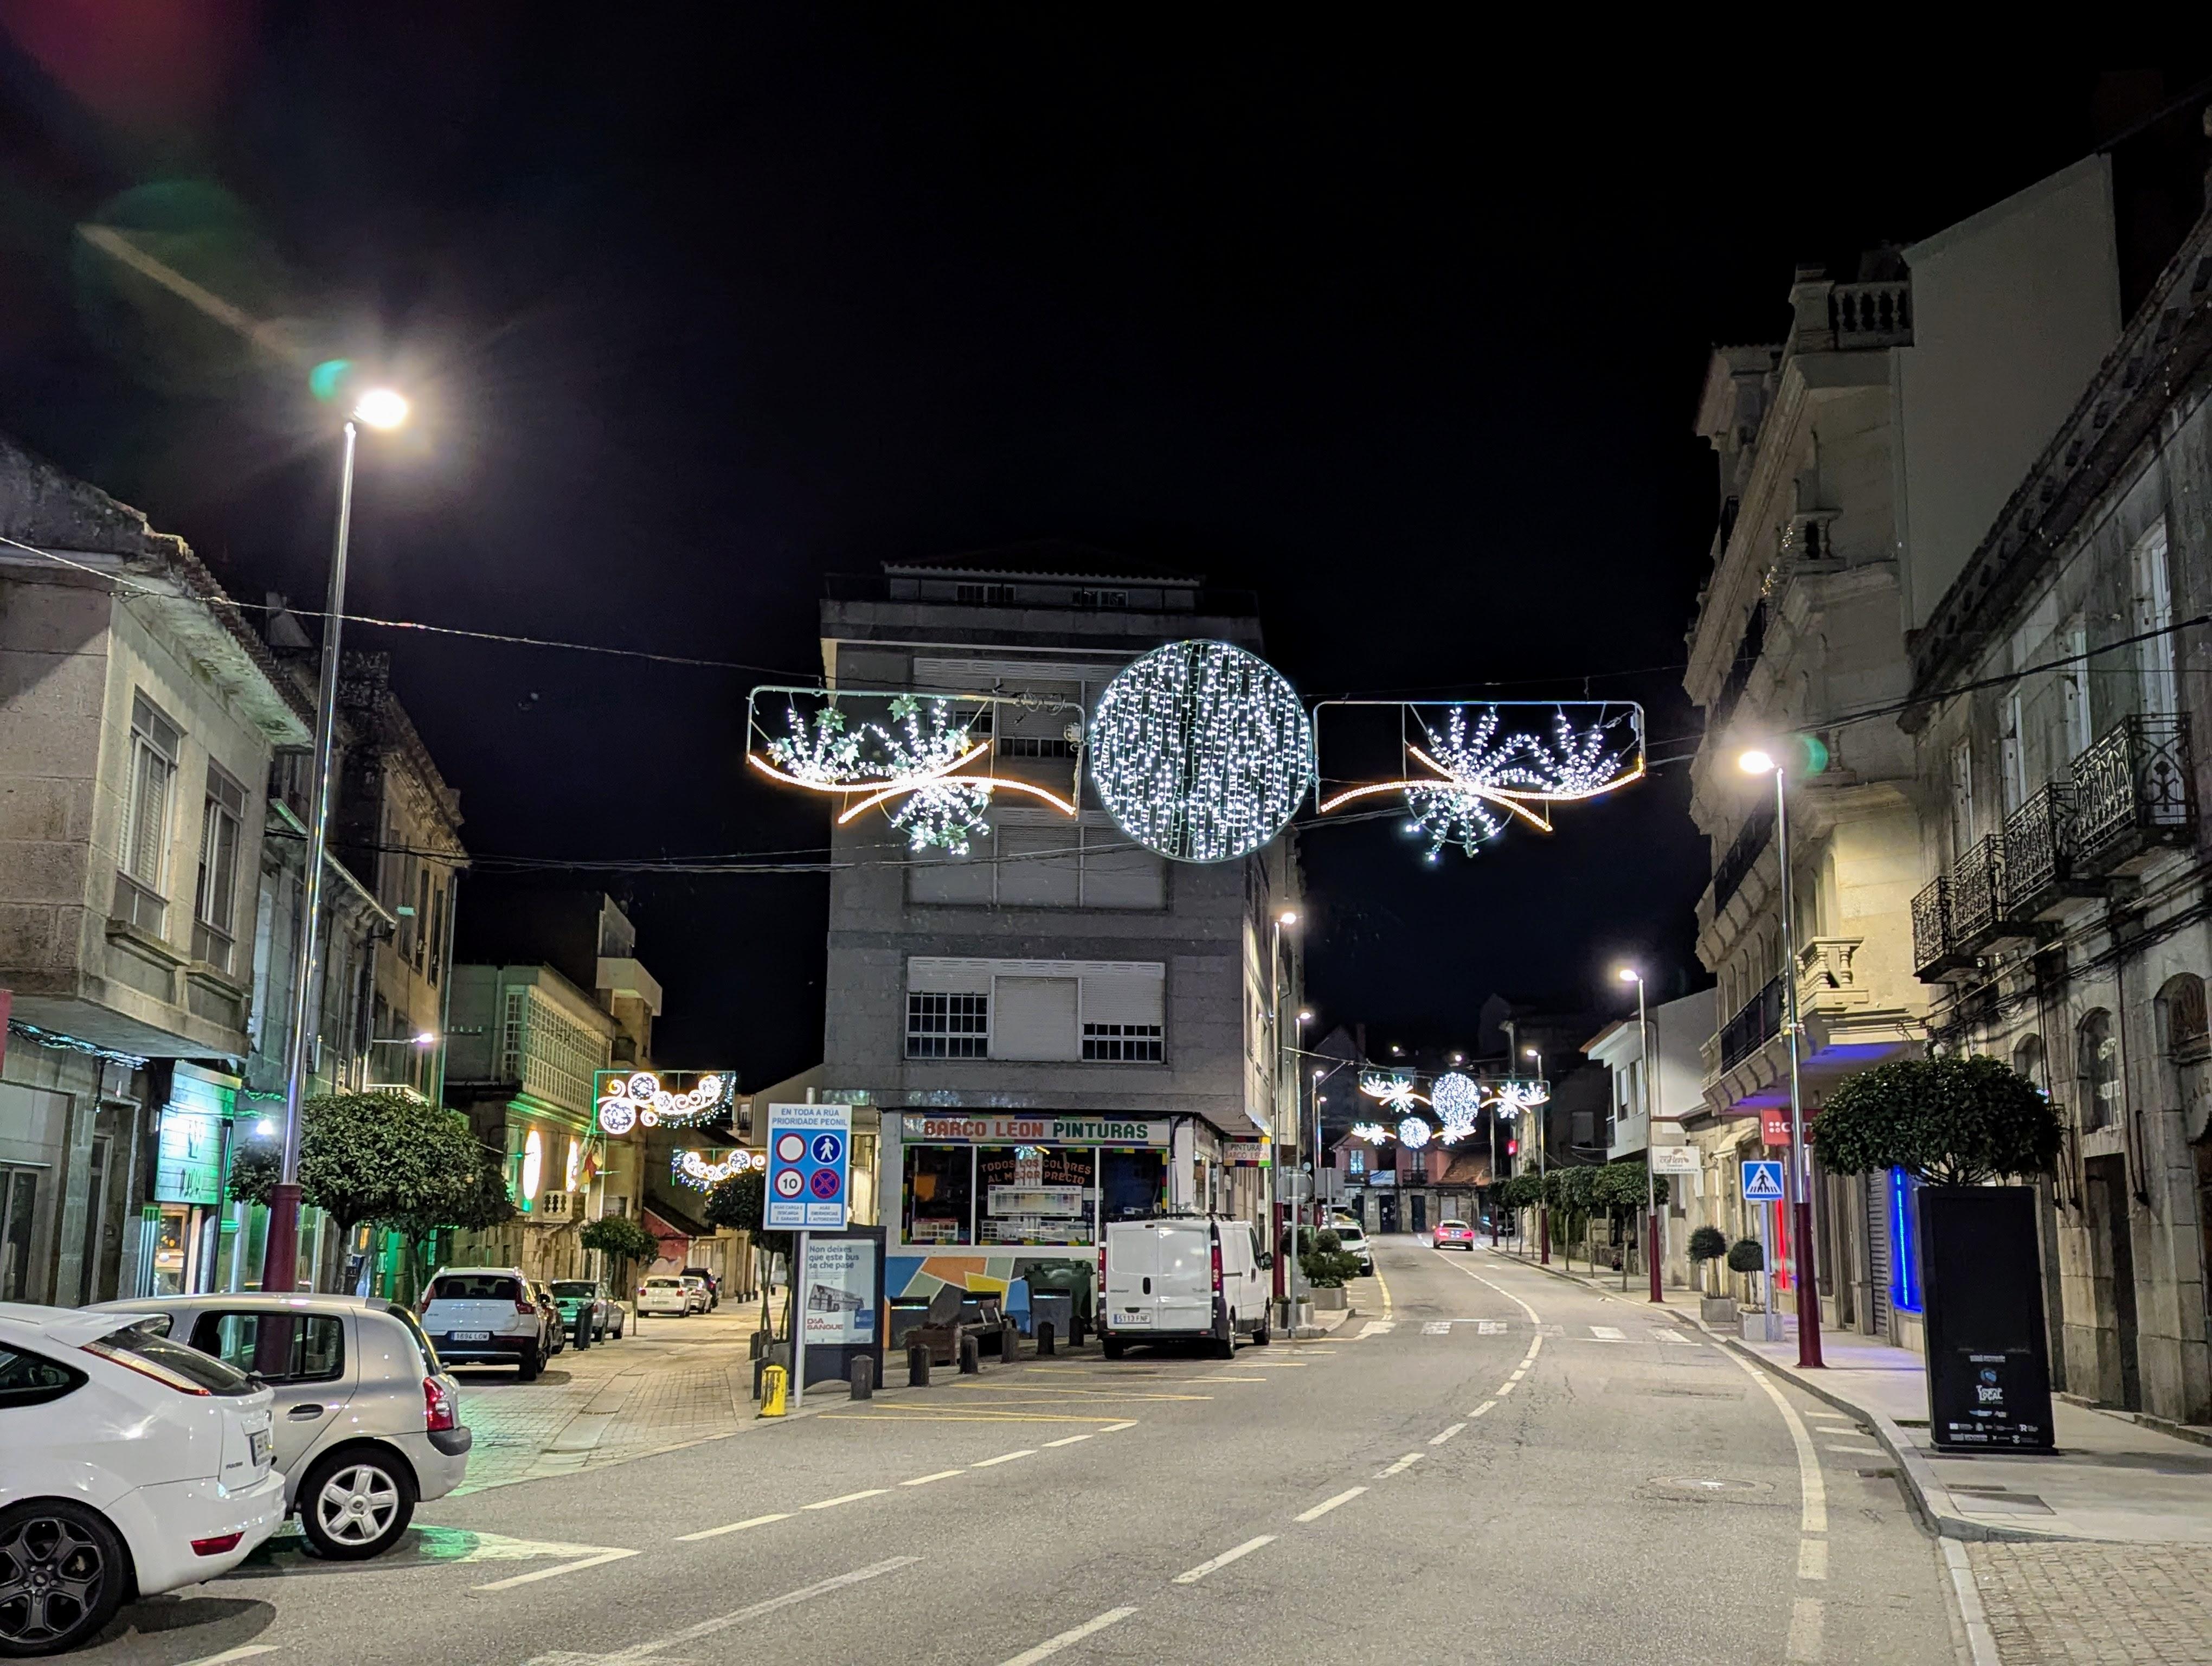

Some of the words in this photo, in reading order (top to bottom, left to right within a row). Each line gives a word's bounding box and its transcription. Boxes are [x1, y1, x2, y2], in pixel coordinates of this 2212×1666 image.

[772, 1117, 818, 1125] PRIORIDADE
[924, 1120, 987, 1137] BARCO
[995, 1122, 1044, 1137] LEON
[1053, 1122, 1148, 1138] PINTURAS
[980, 1159, 1015, 1172] TODOS
[1020, 1159, 1039, 1167] LOS
[1043, 1159, 1092, 1175] COLORES
[783, 1178, 798, 1189] 10
[988, 1174, 1001, 1183] AL
[1004, 1171, 1041, 1180] MEJOR
[1044, 1171, 1085, 1184] PRECIO
[835, 1262, 854, 1270] pase
